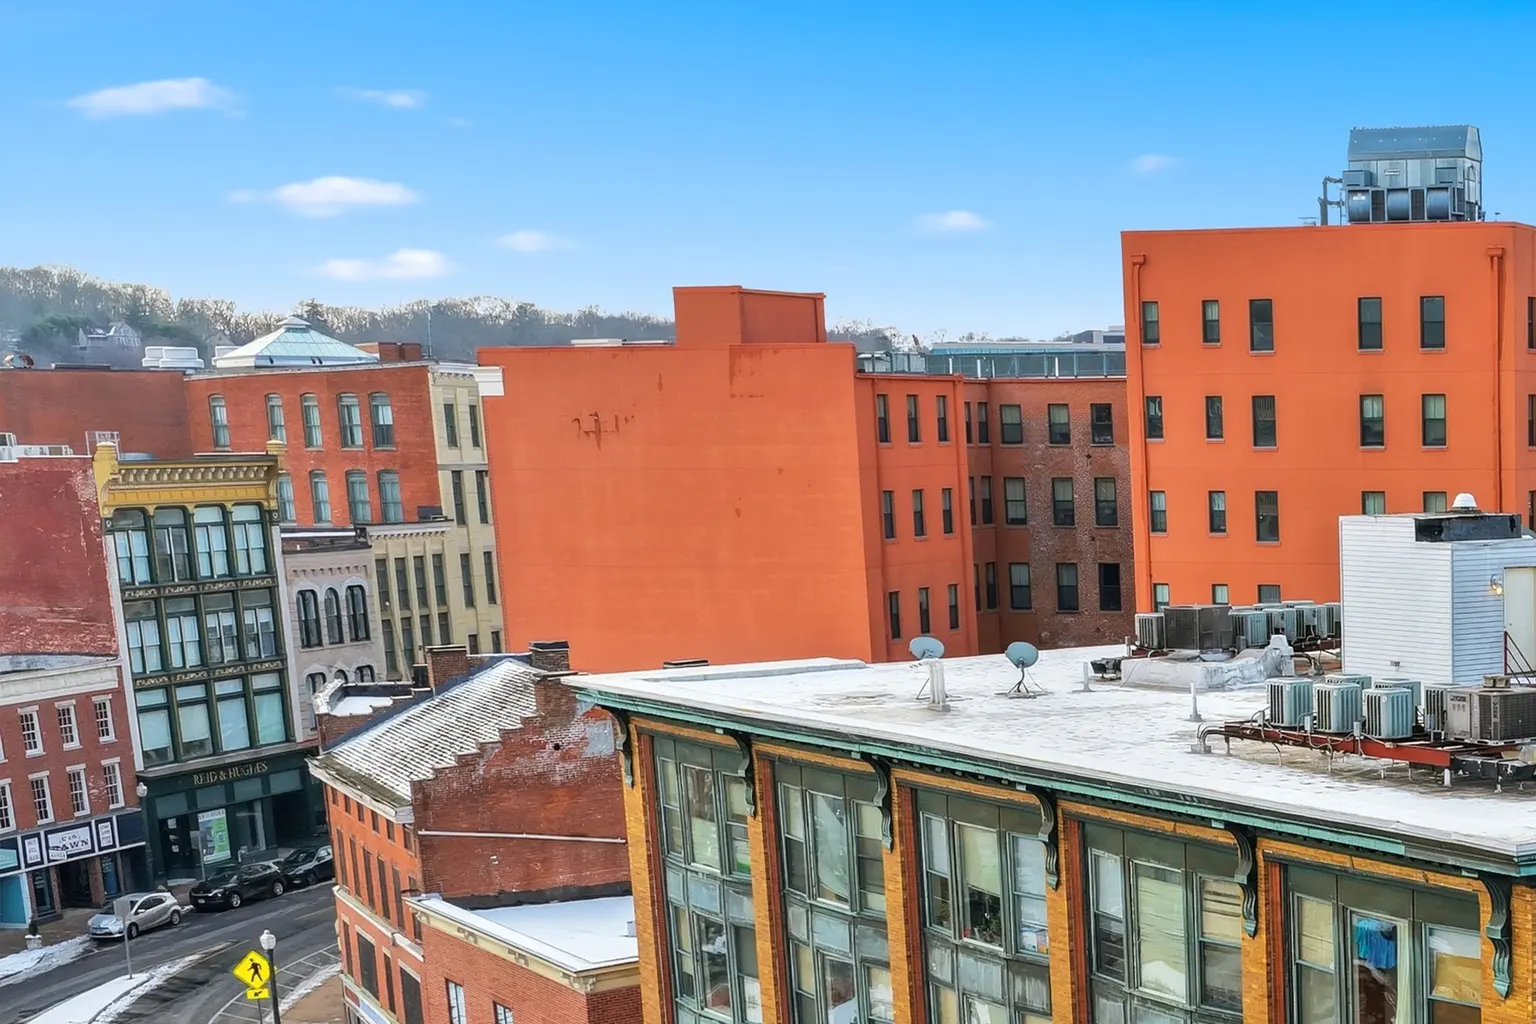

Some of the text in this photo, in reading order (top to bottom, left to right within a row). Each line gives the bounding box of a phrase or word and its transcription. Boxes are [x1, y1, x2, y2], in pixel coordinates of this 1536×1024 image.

[193, 761, 268, 785] REID & HUGHES
